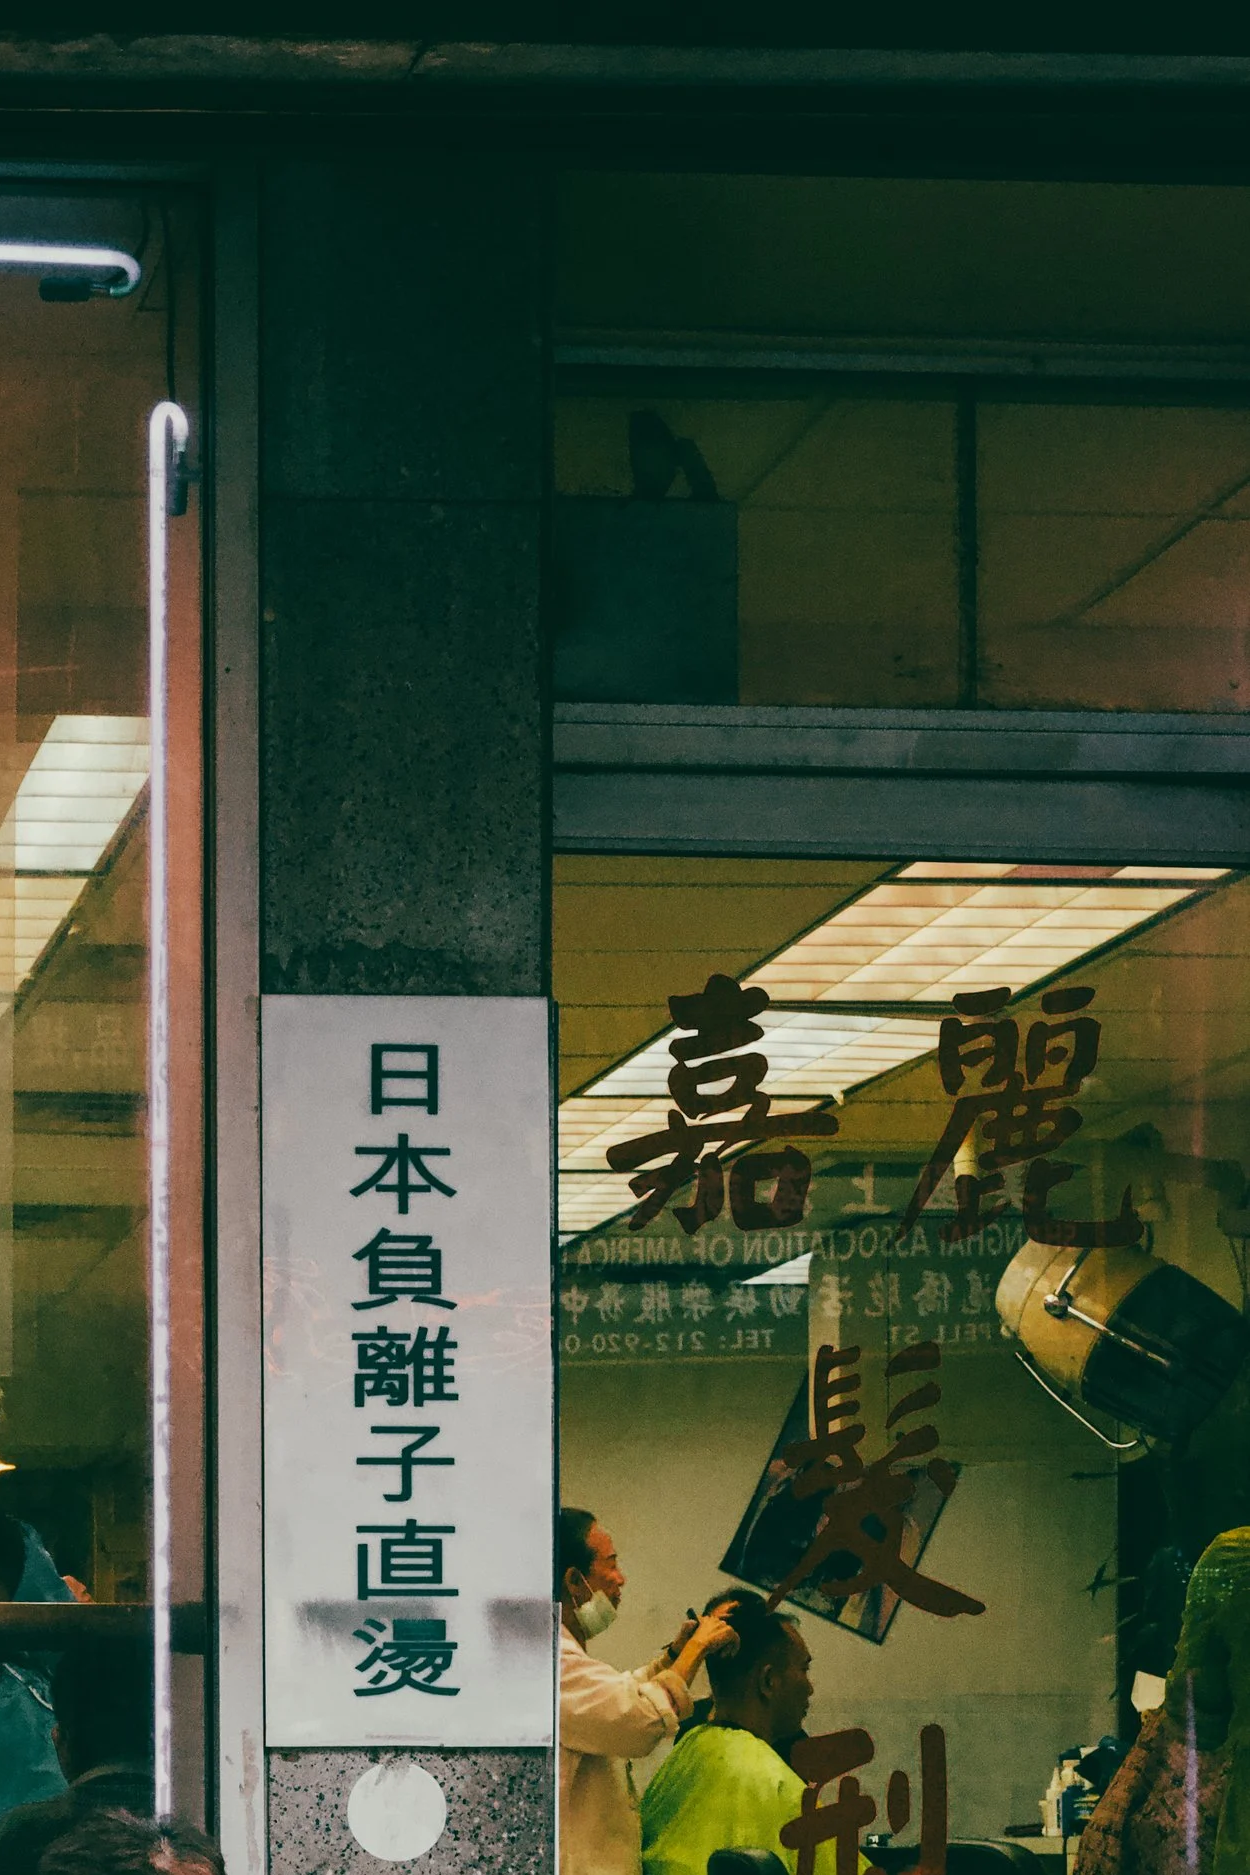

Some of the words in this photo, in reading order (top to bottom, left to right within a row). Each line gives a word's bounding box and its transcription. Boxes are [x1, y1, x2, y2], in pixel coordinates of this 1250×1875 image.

[606, 973, 1145, 1247] 嘉麗
[350, 1043, 461, 1698] 日本負離子直燙
